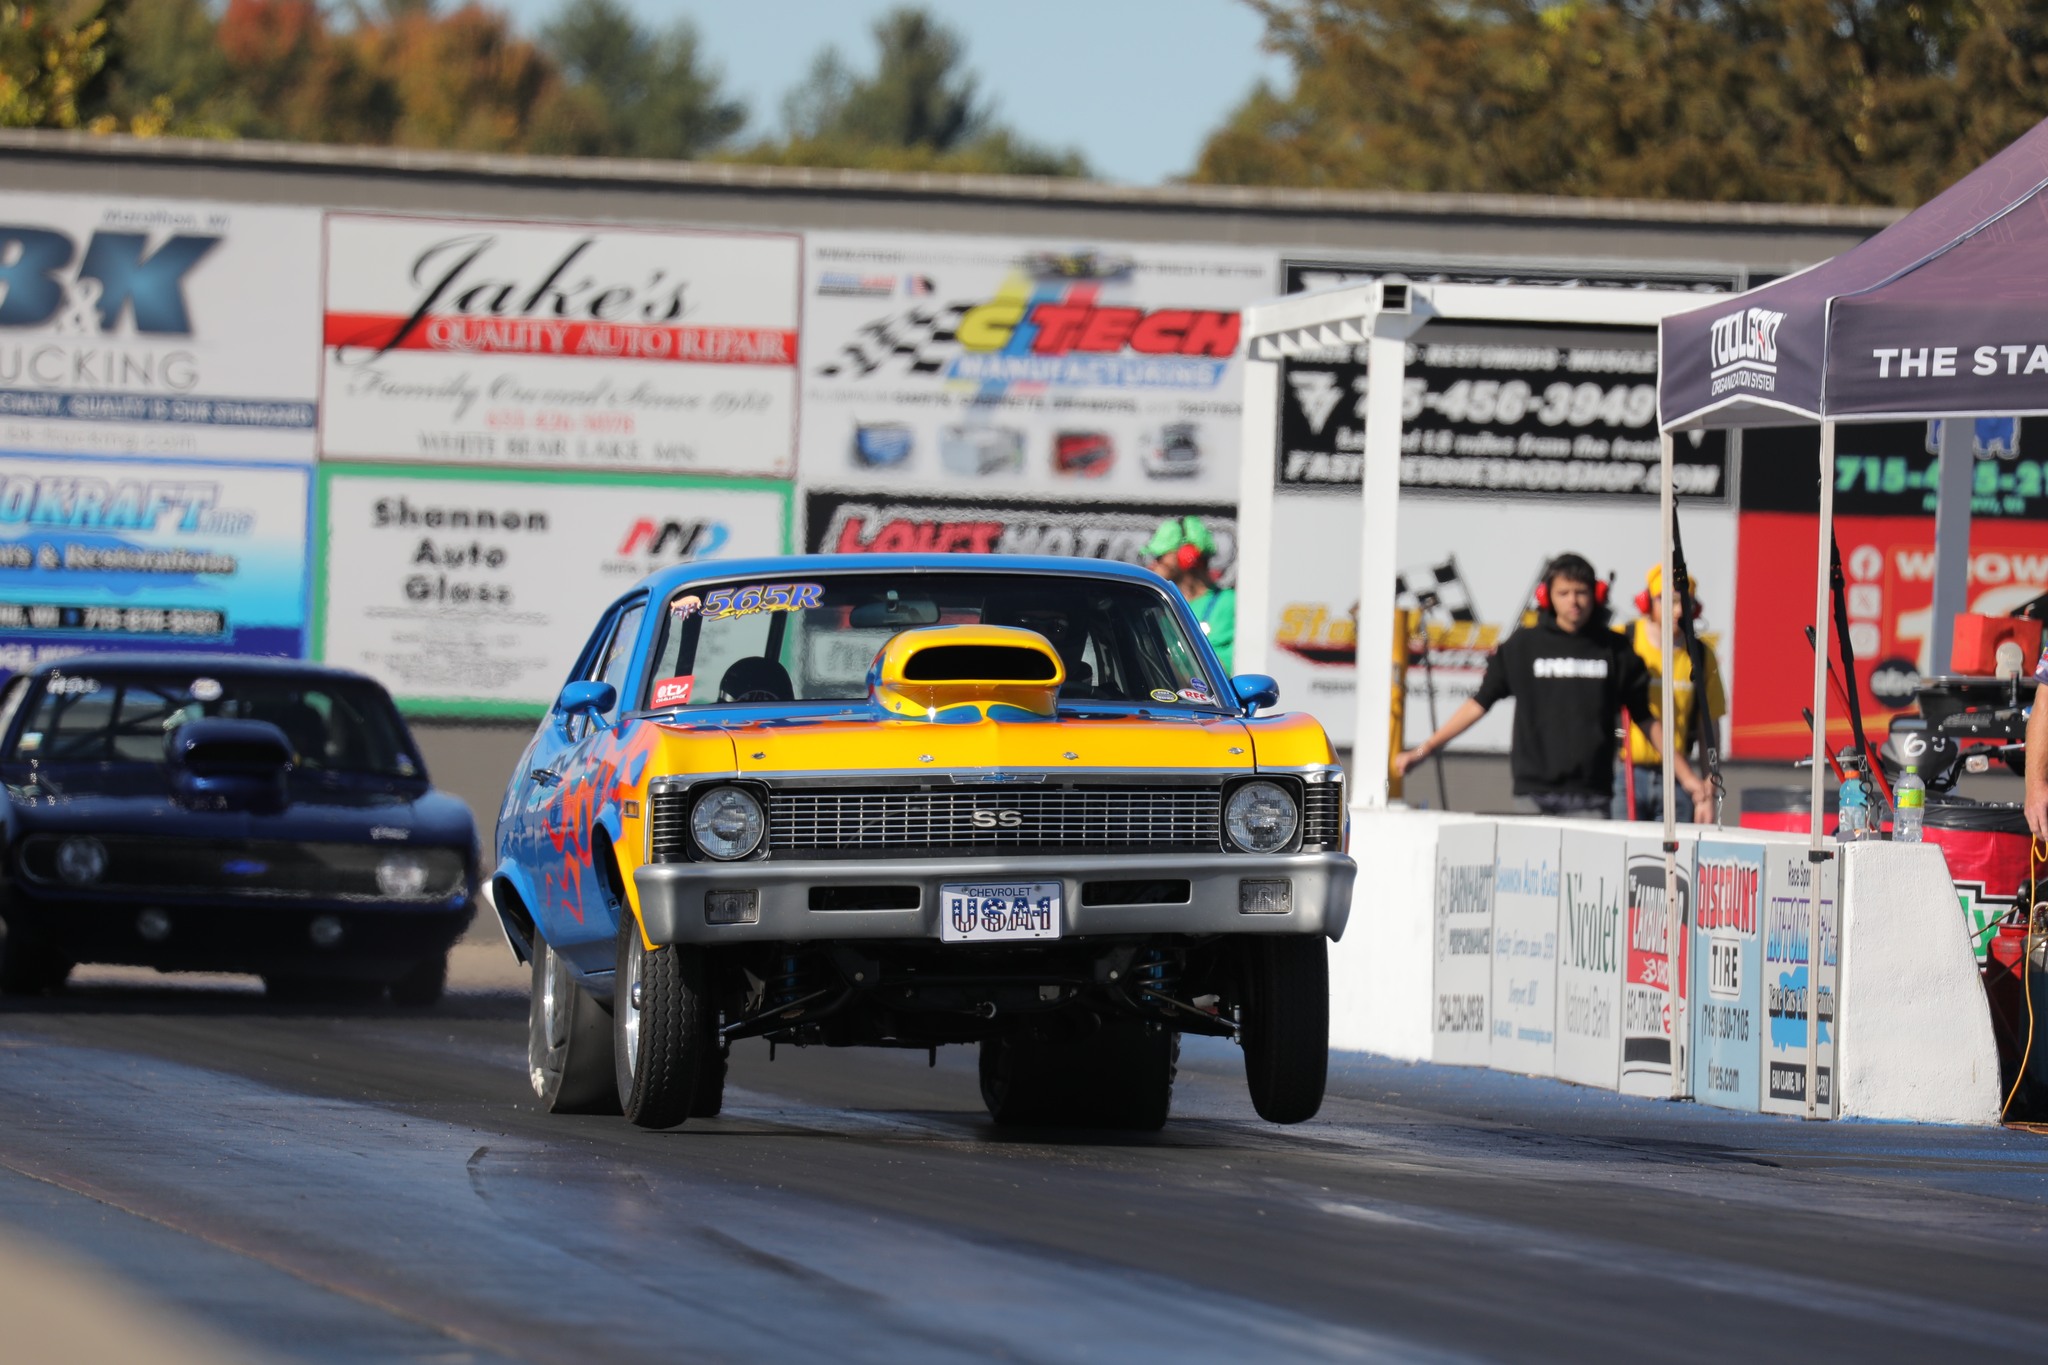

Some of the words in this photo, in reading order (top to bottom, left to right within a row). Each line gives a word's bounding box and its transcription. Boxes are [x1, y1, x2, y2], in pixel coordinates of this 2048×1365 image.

[335, 232, 690, 367] Jake's
[425, 316, 569, 353] QUALITY
[577, 326, 673, 358] AUTO
[677, 330, 788, 362] REPAIR
[1710, 306, 1780, 369] TOOLGRID
[956, 354, 1218, 388] MANUFACTURING
[1872, 346, 1958, 379] THE
[1971, 343, 2048, 376] STA
[345, 366, 478, 421] Family
[1352, 371, 1658, 429] 75-456-3949
[1711, 370, 1751, 397] ORGANIZATION
[1751, 373, 1776, 393] SYSTEM
[417, 432, 498, 458] WHITE
[505, 436, 568, 459] BEAR
[1573, 433, 1610, 461] the
[372, 494, 550, 533] Shannon
[411, 536, 507, 569] Auto
[1896, 550, 2048, 585] WOW
[404, 573, 514, 605] Glass
[699, 583, 826, 618] 565R
[971, 809, 1023, 828] SS
[968, 886, 1032, 898] CHEVROLET
[1787, 859, 1799, 886] Race
[1799, 863, 1811, 894] Spor
[951, 896, 1051, 933] USA-1
[1697, 859, 1758, 937] DISCOUNT
[1562, 871, 1619, 974] Nicolet
[1631, 883, 1685, 958] CARBURER
[1766, 896, 1833, 966] AUTOKFT
[1711, 944, 1738, 989] TIRE
[1565, 980, 1592, 1037] National
[1592, 981, 1612, 1040] Bank
[1768, 983, 1784, 1014] Race
[1783, 983, 1797, 1016] Cars
[1701, 1004, 1717, 1038] (715)
[1717, 1005, 1749, 1042] 930-7105
[1707, 1057, 1739, 1093] tires.com
[1771, 1067, 1781, 1091] EAU
[1781, 1068, 1794, 1096] CLAIRE,
